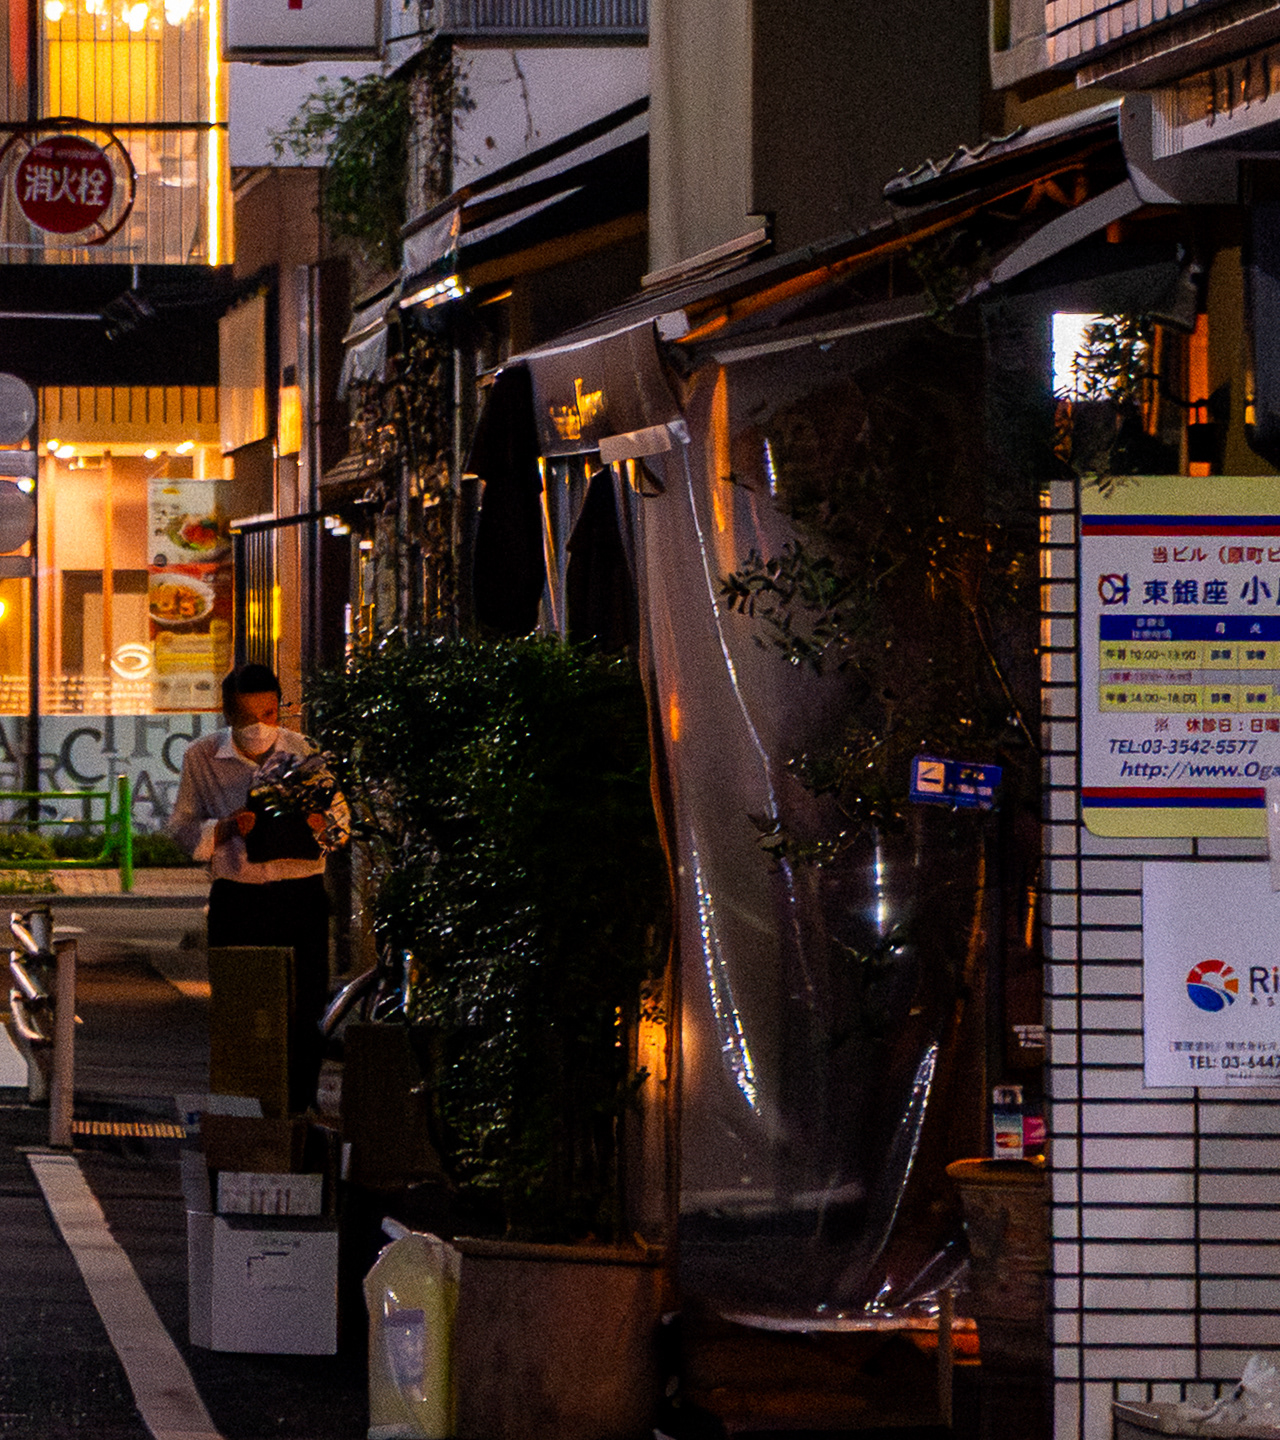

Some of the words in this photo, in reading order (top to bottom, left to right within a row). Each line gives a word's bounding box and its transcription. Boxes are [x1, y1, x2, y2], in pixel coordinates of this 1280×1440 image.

[23, 164, 108, 207] 消火栓
[1142, 578, 1229, 605] 東銀座
[1240, 574, 1280, 605] 小
[1109, 739, 1258, 755] TEL:03-3542-5577
[1249, 965, 1279, 994] Ri
